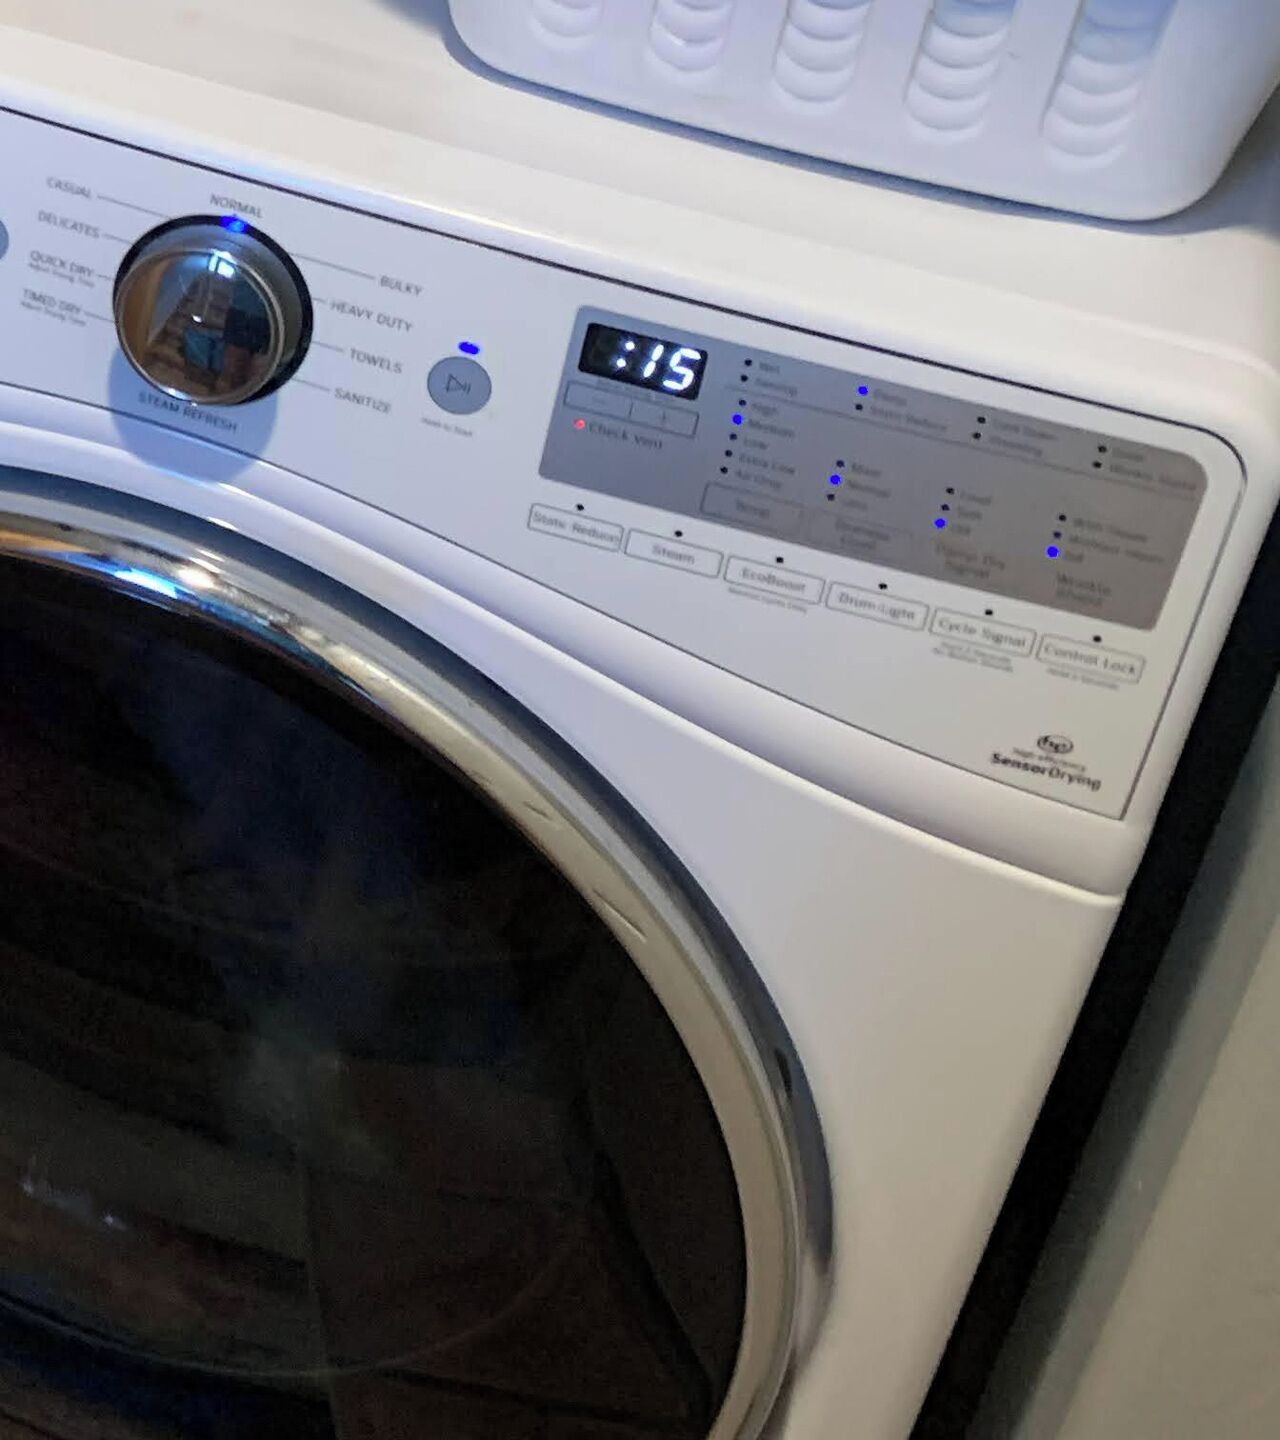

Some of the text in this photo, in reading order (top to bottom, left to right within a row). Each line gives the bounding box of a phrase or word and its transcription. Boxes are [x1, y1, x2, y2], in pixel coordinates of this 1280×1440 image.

[46, 176, 92, 199] CASUAL
[209, 193, 264, 219] NORMAL
[38, 211, 101, 239] DELICATES
[29, 250, 95, 277] QUICK DRY
[379, 274, 425, 296] BULKY
[329, 299, 414, 334] HEAVY DUTY
[349, 347, 404, 375] TOWELS
[137, 391, 238, 433] STEAM REFRESH
[333, 387, 394, 414] SANITIZE
[589, 422, 630, 442] Check
[532, 510, 567, 531] Static
[651, 542, 695, 565] Steam
[741, 566, 806, 592] EcoBoost
[938, 616, 1026, 651] Cycle Signal
[1043, 642, 1098, 667] Control
[1102, 654, 1137, 676] Lock
[990, 752, 1102, 792] SensorDrying
